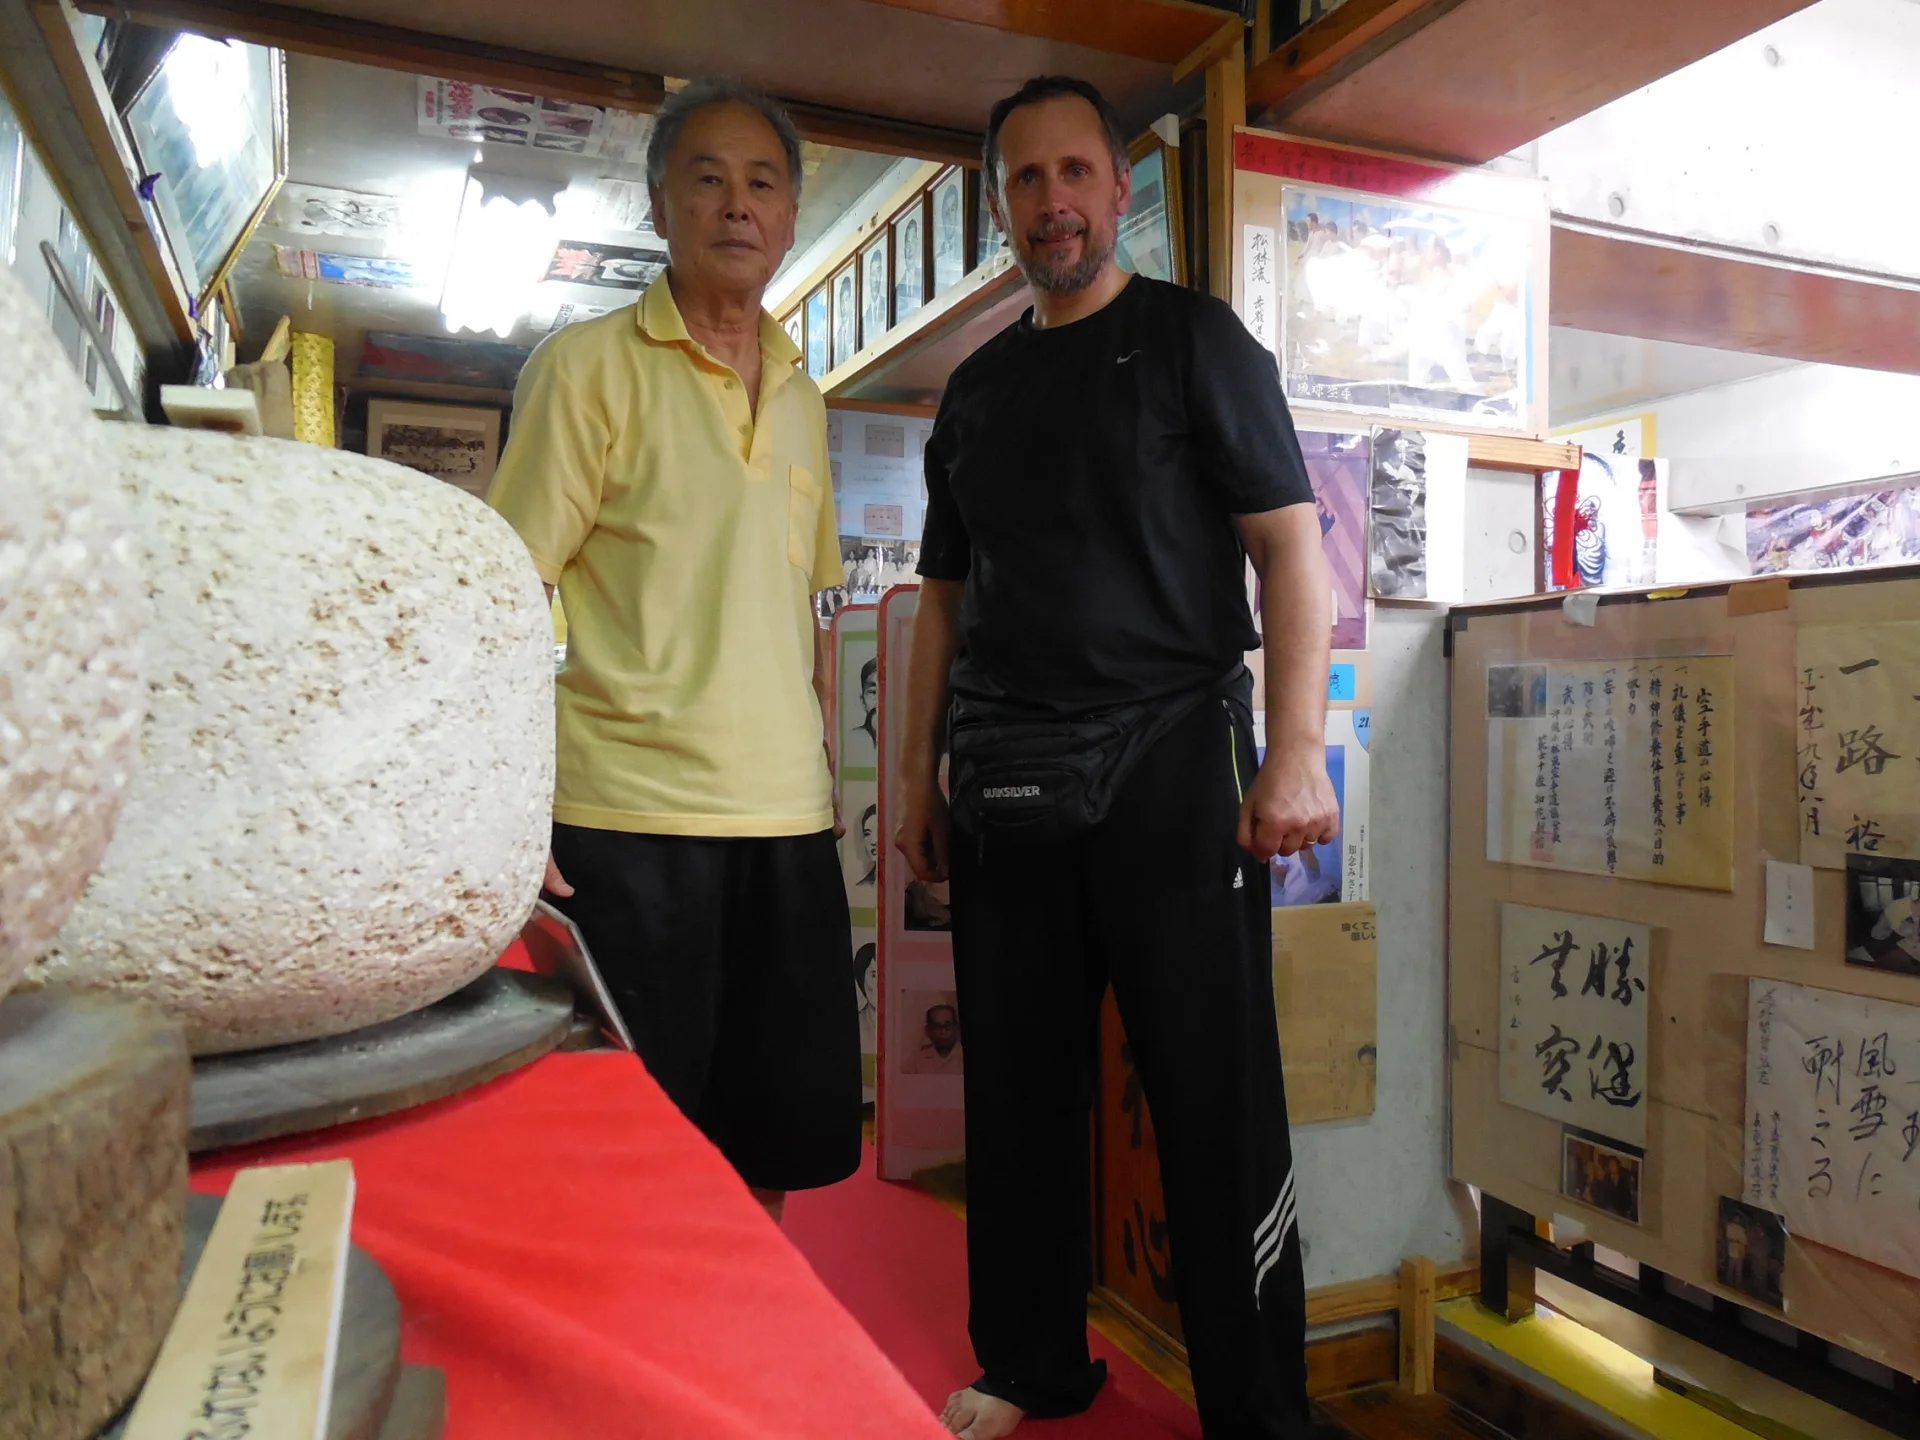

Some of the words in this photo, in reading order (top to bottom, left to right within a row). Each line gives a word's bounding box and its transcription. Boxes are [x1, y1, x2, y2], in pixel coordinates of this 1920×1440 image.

[1250, 231, 1271, 285] 松林流
[1296, 382, 1351, 401] 琉球空手
[1696, 687, 1713, 807] 空手道の心得
[983, 785, 1041, 799] QUIKSILVER
[1848, 1032, 1896, 1202] 風雪に
